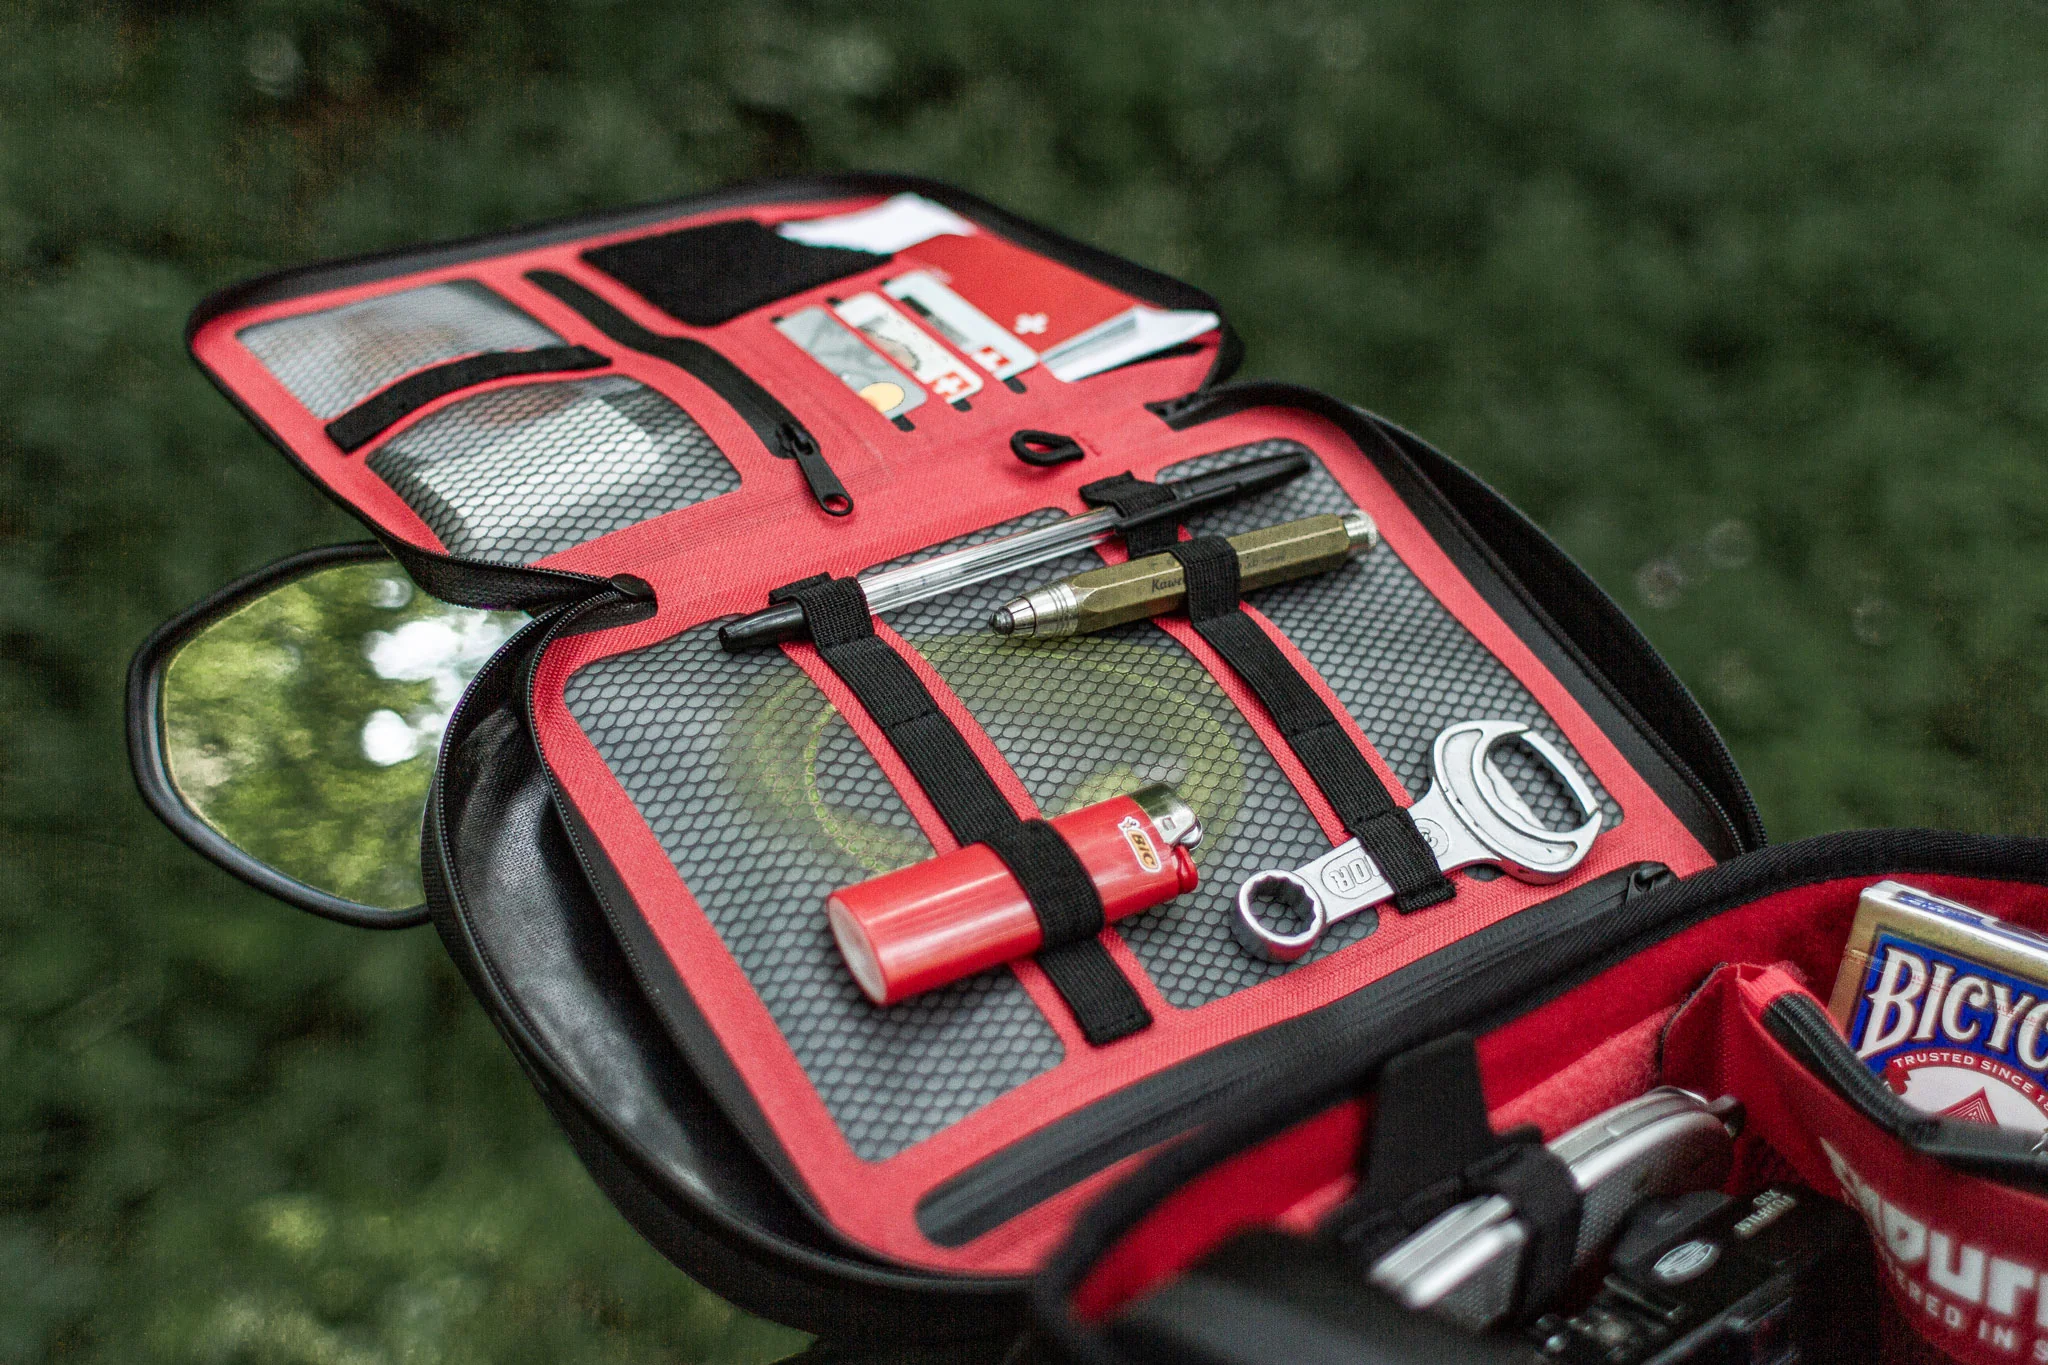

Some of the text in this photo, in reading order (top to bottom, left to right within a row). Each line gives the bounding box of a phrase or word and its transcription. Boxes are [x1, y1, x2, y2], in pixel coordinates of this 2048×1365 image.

[1130, 833, 1156, 867] BIC
[1893, 1052, 1974, 1068] TRUSTED
[1980, 1060, 2033, 1093] SINCE
[1978, 1318, 2014, 1350] IN
